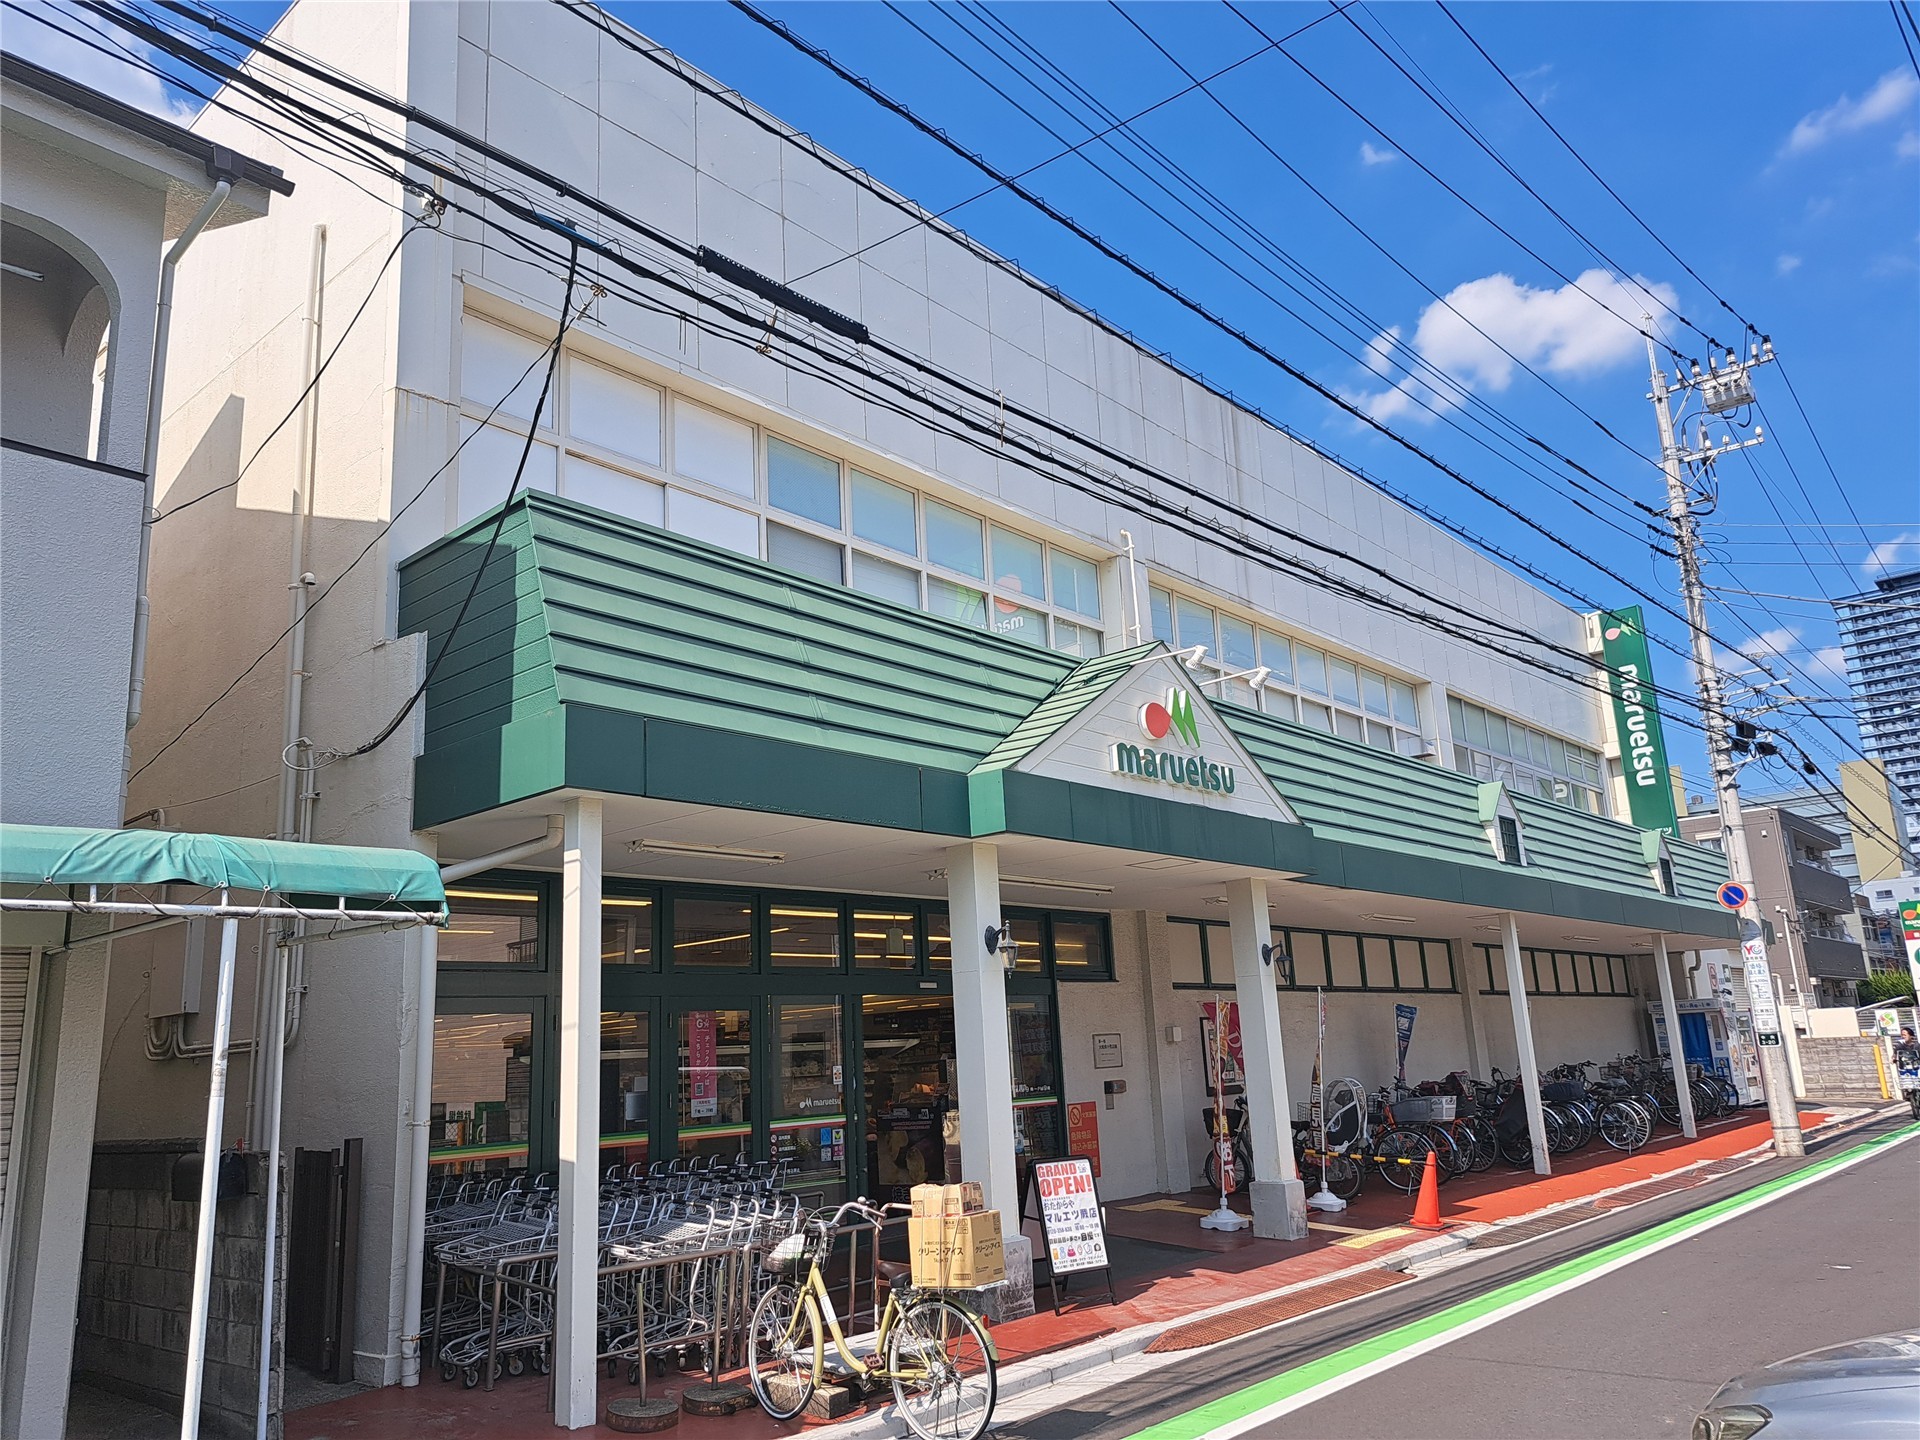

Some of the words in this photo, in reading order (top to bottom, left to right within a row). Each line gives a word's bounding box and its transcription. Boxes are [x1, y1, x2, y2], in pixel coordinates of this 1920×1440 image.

[1618, 663, 1656, 787] maruetsu
[1114, 742, 1235, 794] maruetsu
[813, 1097, 841, 1107] maruetsu
[1037, 1163, 1077, 1178] GRAND
[1039, 1175, 1093, 1198] OPEN!
[1043, 1199, 1075, 1212] おたからや
[918, 1247, 964, 1256] クリーン・アイス
